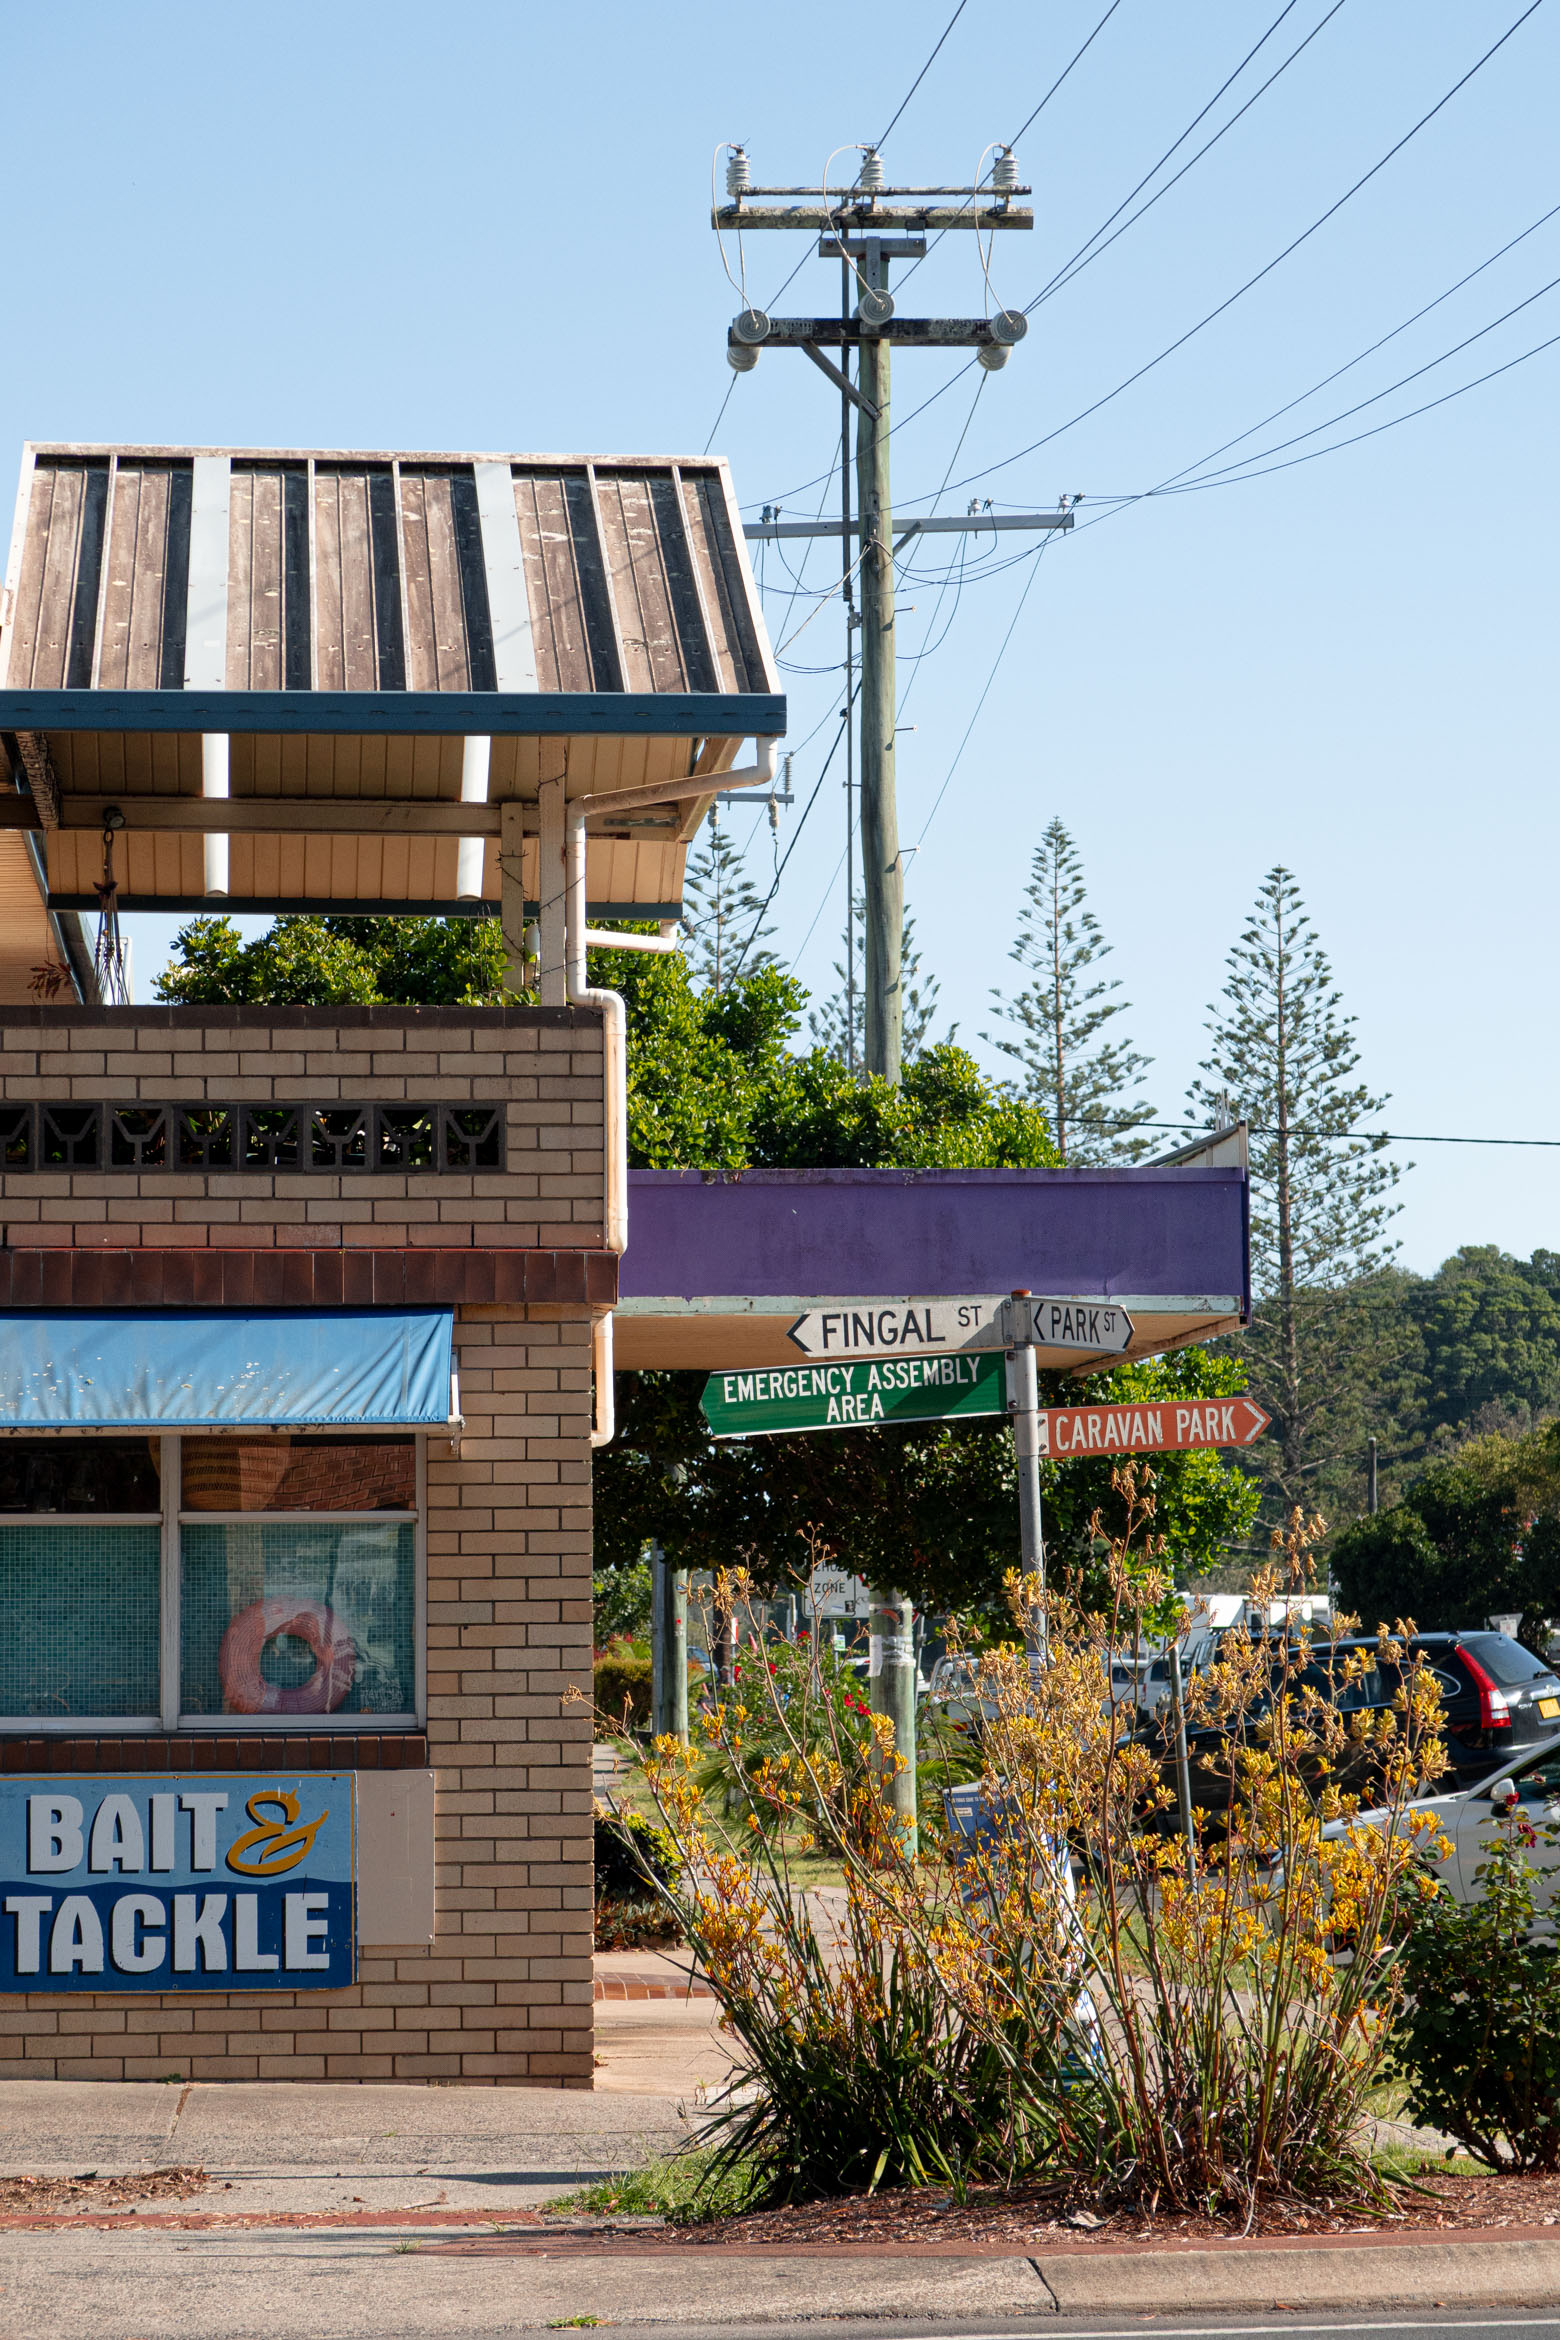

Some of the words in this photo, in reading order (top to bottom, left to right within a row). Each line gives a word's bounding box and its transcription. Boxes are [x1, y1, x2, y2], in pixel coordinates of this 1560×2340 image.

[822, 1309, 946, 1349] FINGAL
[957, 1305, 983, 1327] ST
[1052, 1308, 1101, 1344] PARK
[1104, 1313, 1117, 1333] ST
[723, 1366, 855, 1403] EMERGENCY
[867, 1357, 980, 1391] ASSEMBLY
[826, 1393, 884, 1424] AREA
[1055, 1411, 1163, 1451] CARAVAN
[1177, 1406, 1237, 1443] PARK
[814, 1582, 847, 1594] ZONE
[27, 1793, 229, 1873] BAIT
[225, 1788, 330, 1877] &
[3, 1893, 330, 1976] TACKLE
